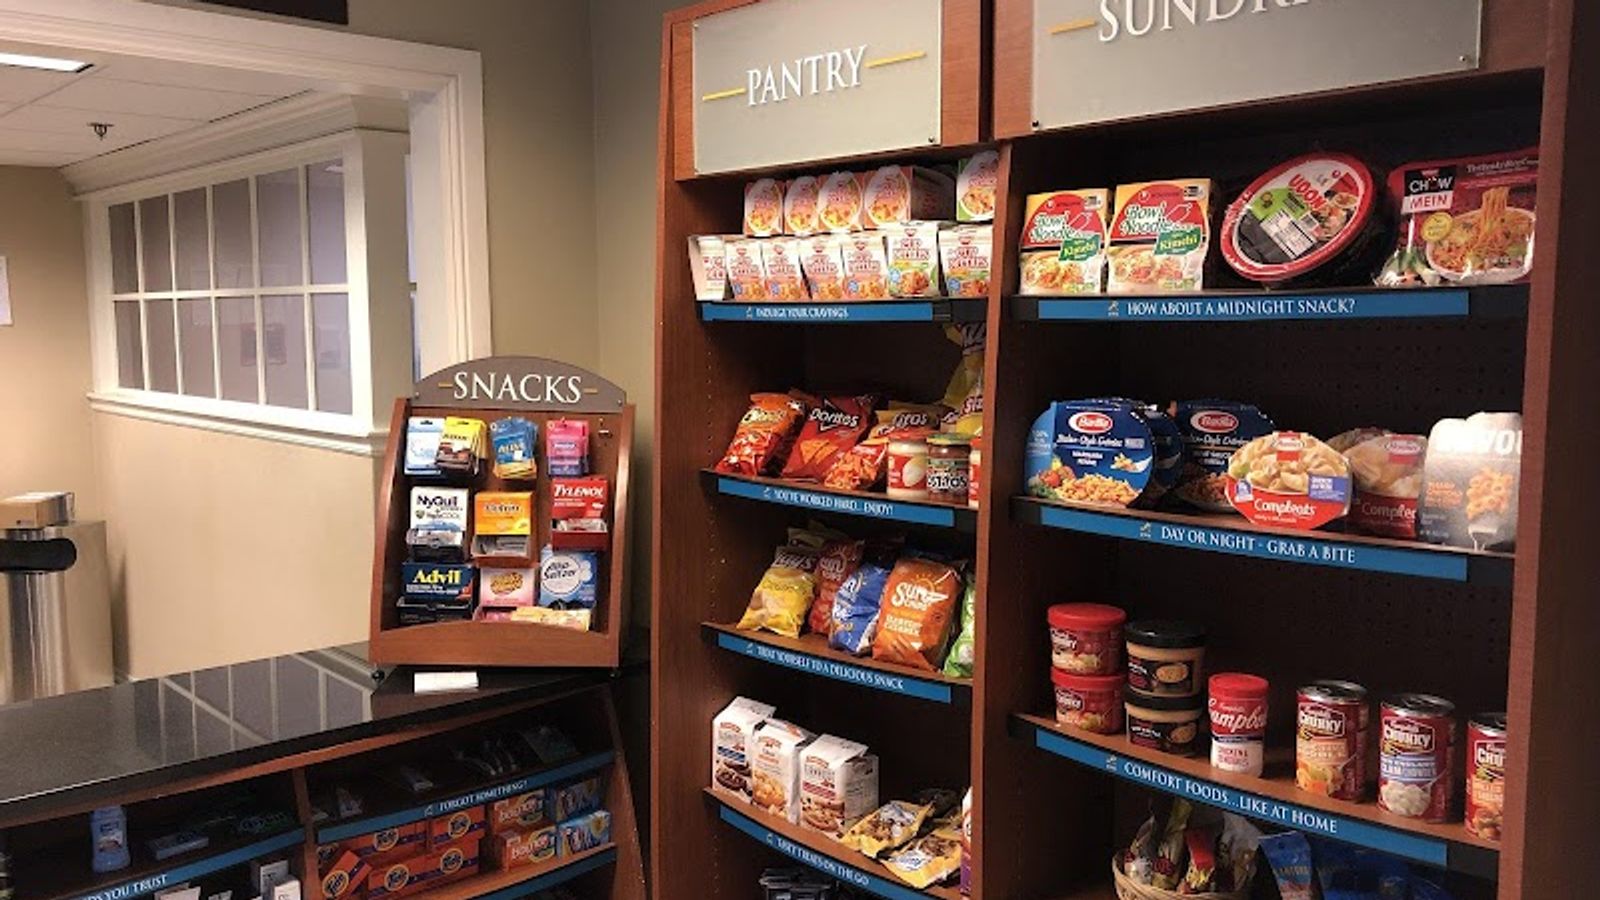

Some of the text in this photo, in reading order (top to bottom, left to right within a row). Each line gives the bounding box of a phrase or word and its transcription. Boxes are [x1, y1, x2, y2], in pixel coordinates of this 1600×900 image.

[747, 45, 868, 106] PANTRY
[1289, 173, 1328, 209] UDON
[1410, 194, 1447, 208] MEIN
[1128, 298, 1356, 316] HOW ABOUT A MIDNIGHT SNACK?
[454, 371, 582, 403] SNACKS
[810, 407, 860, 428] Doritos
[417, 495, 458, 509] NyQuil
[553, 484, 604, 499] TYLENOL
[1254, 498, 1317, 516] Compleats
[1162, 526, 1185, 540] DAY
[1188, 530, 1208, 543] OR
[1210, 531, 1255, 551] NIGHT
[1266, 539, 1306, 557] GRAB
[1309, 545, 1318, 558] A
[1322, 546, 1356, 563] BITE
[412, 569, 463, 585] Advil
[1124, 761, 1182, 789] COMFORT
[1271, 805, 1288, 820] AT
[1292, 809, 1337, 834] HOME
[104, 873, 168, 900] YOU TRUST
